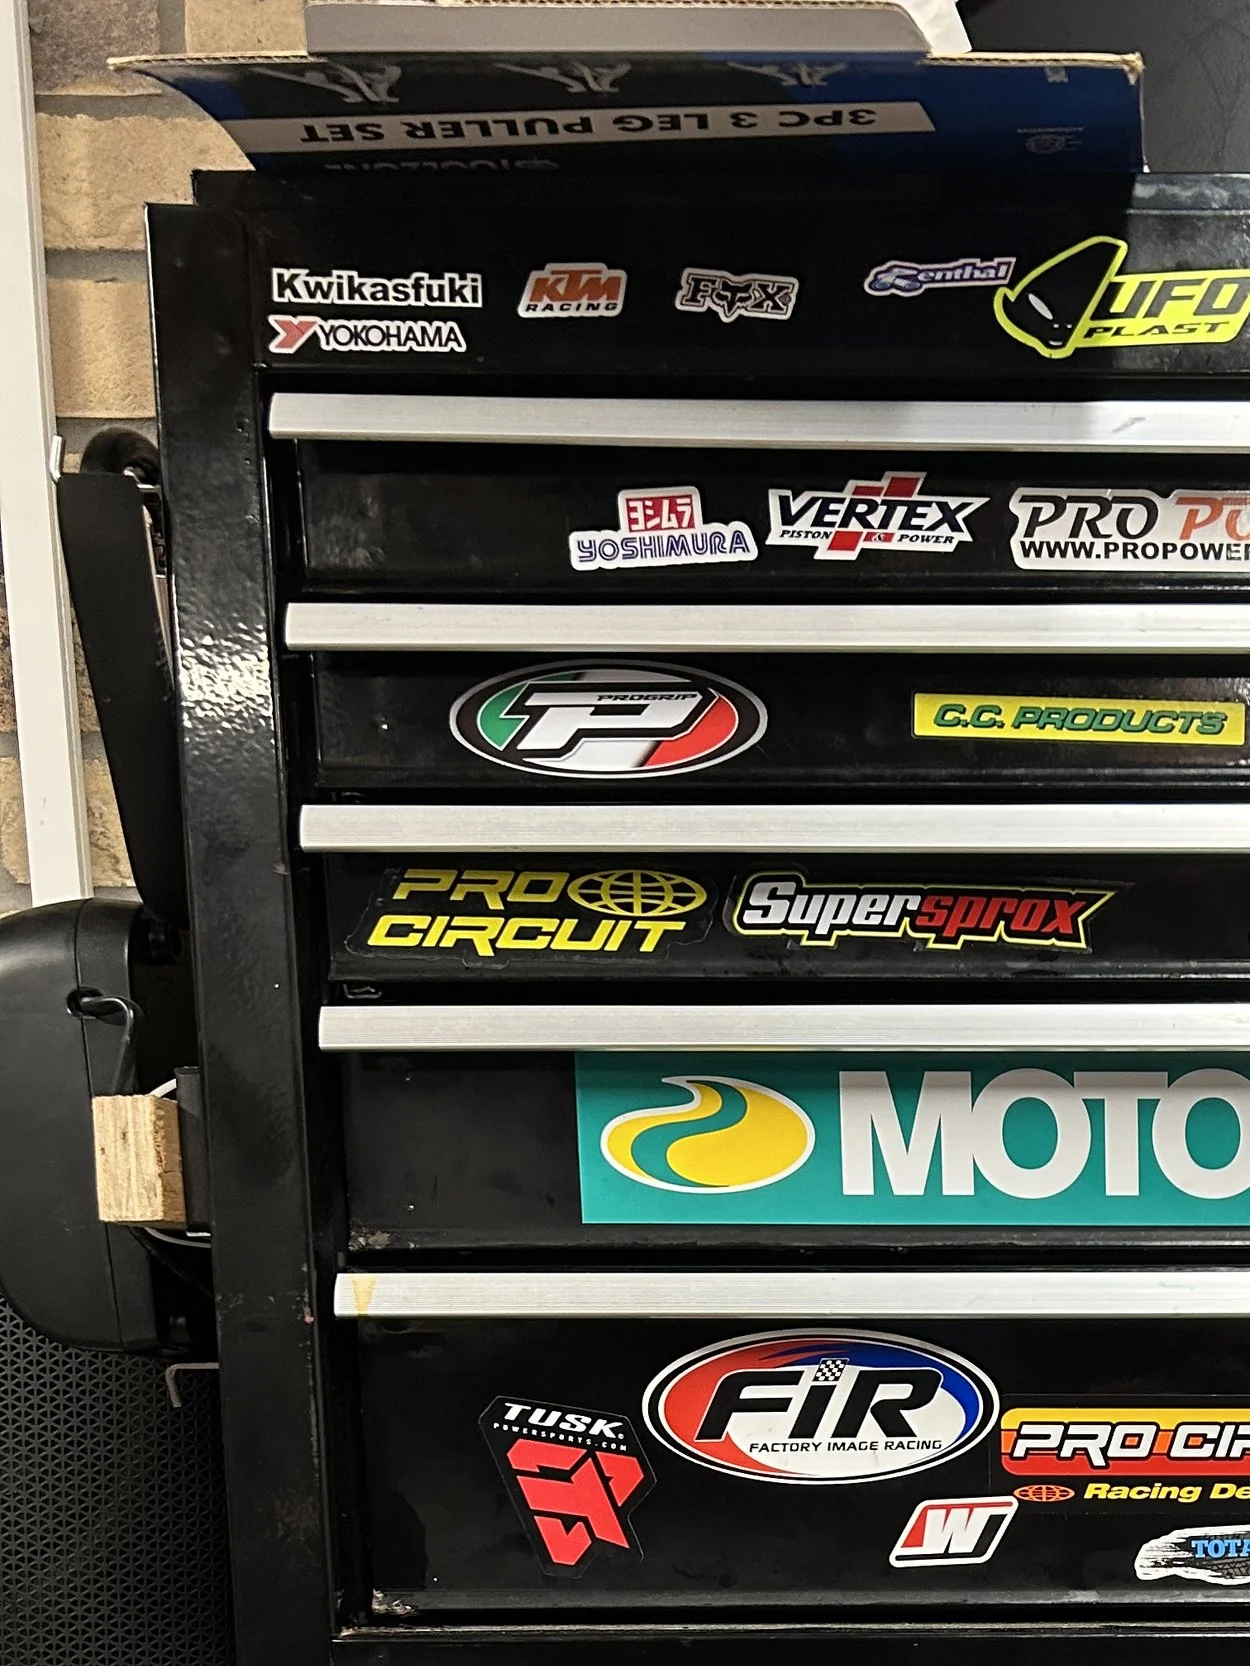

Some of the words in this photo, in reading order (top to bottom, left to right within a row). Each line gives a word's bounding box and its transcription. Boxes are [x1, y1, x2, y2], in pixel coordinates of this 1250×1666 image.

[403, 116, 594, 139] PULLER
[612, 112, 708, 132] LEG
[731, 111, 757, 129] 3
[778, 109, 877, 127] 3PC
[301, 122, 385, 143] SET
[275, 272, 480, 304] Kwikasfuki
[530, 270, 621, 302] KTM
[525, 303, 618, 312] RACING
[318, 324, 463, 348] YOKOHAMA
[1083, 321, 1229, 339] PLAST
[627, 497, 695, 532] ヨシムラ
[776, 494, 977, 534] VERTEX
[1018, 494, 1159, 540] PRO
[576, 530, 751, 563] YOSHIMURA
[778, 528, 833, 540] PISTON
[896, 533, 955, 545] POWER
[596, 692, 699, 702] PROGRIP
[933, 702, 1005, 729] C.C.
[1012, 705, 1229, 736] PRODUCTS
[392, 868, 571, 911] PRO
[367, 914, 688, 957] CIRCUIT
[503, 1402, 624, 1439] TUSK
[492, 1422, 628, 1452] POWERSPORTS.COM
[749, 1441, 822, 1453] FACTORY
[826, 1440, 880, 1453] IMAGE
[883, 1439, 943, 1452] RACING
[1012, 1423, 1157, 1468] PRO
[1083, 1482, 1202, 1503] Racing
